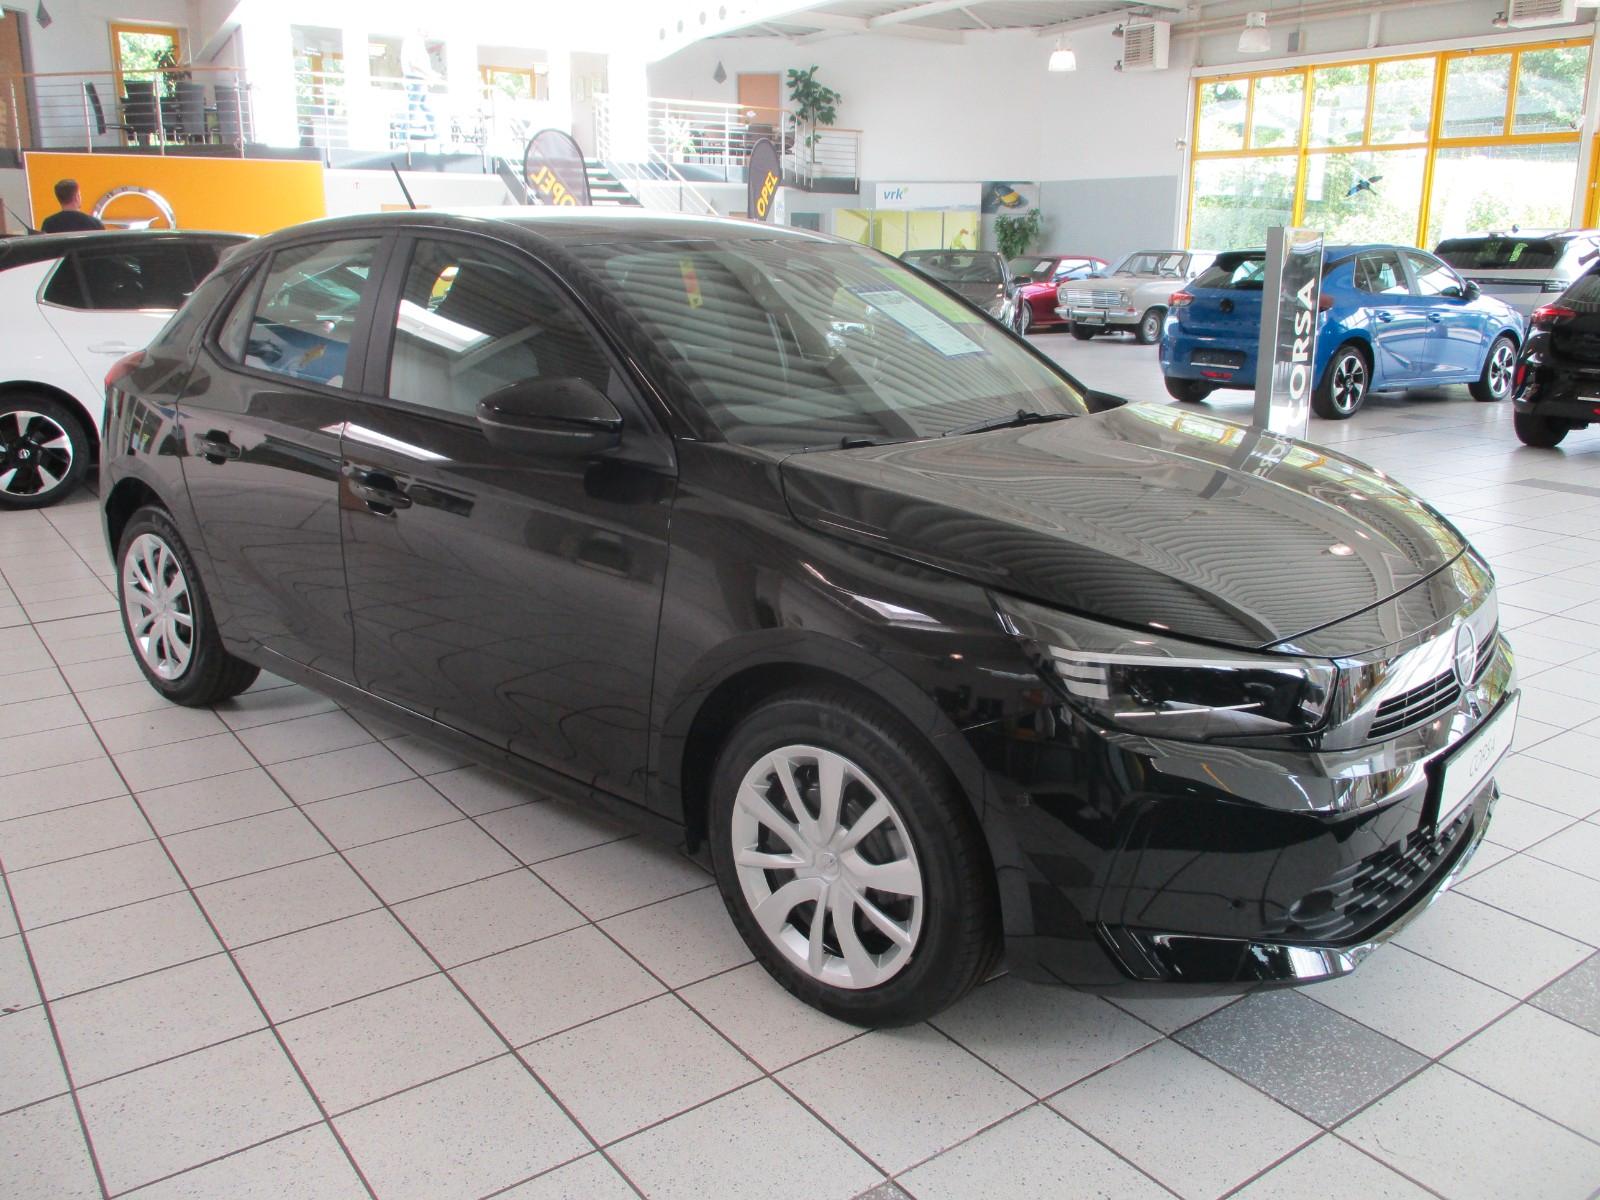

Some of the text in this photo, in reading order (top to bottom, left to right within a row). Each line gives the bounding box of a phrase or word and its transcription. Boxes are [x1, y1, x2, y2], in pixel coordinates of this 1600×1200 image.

[757, 171, 778, 217] OPEL
[883, 188, 904, 200] vrk
[1289, 278, 1315, 426] CORSA
